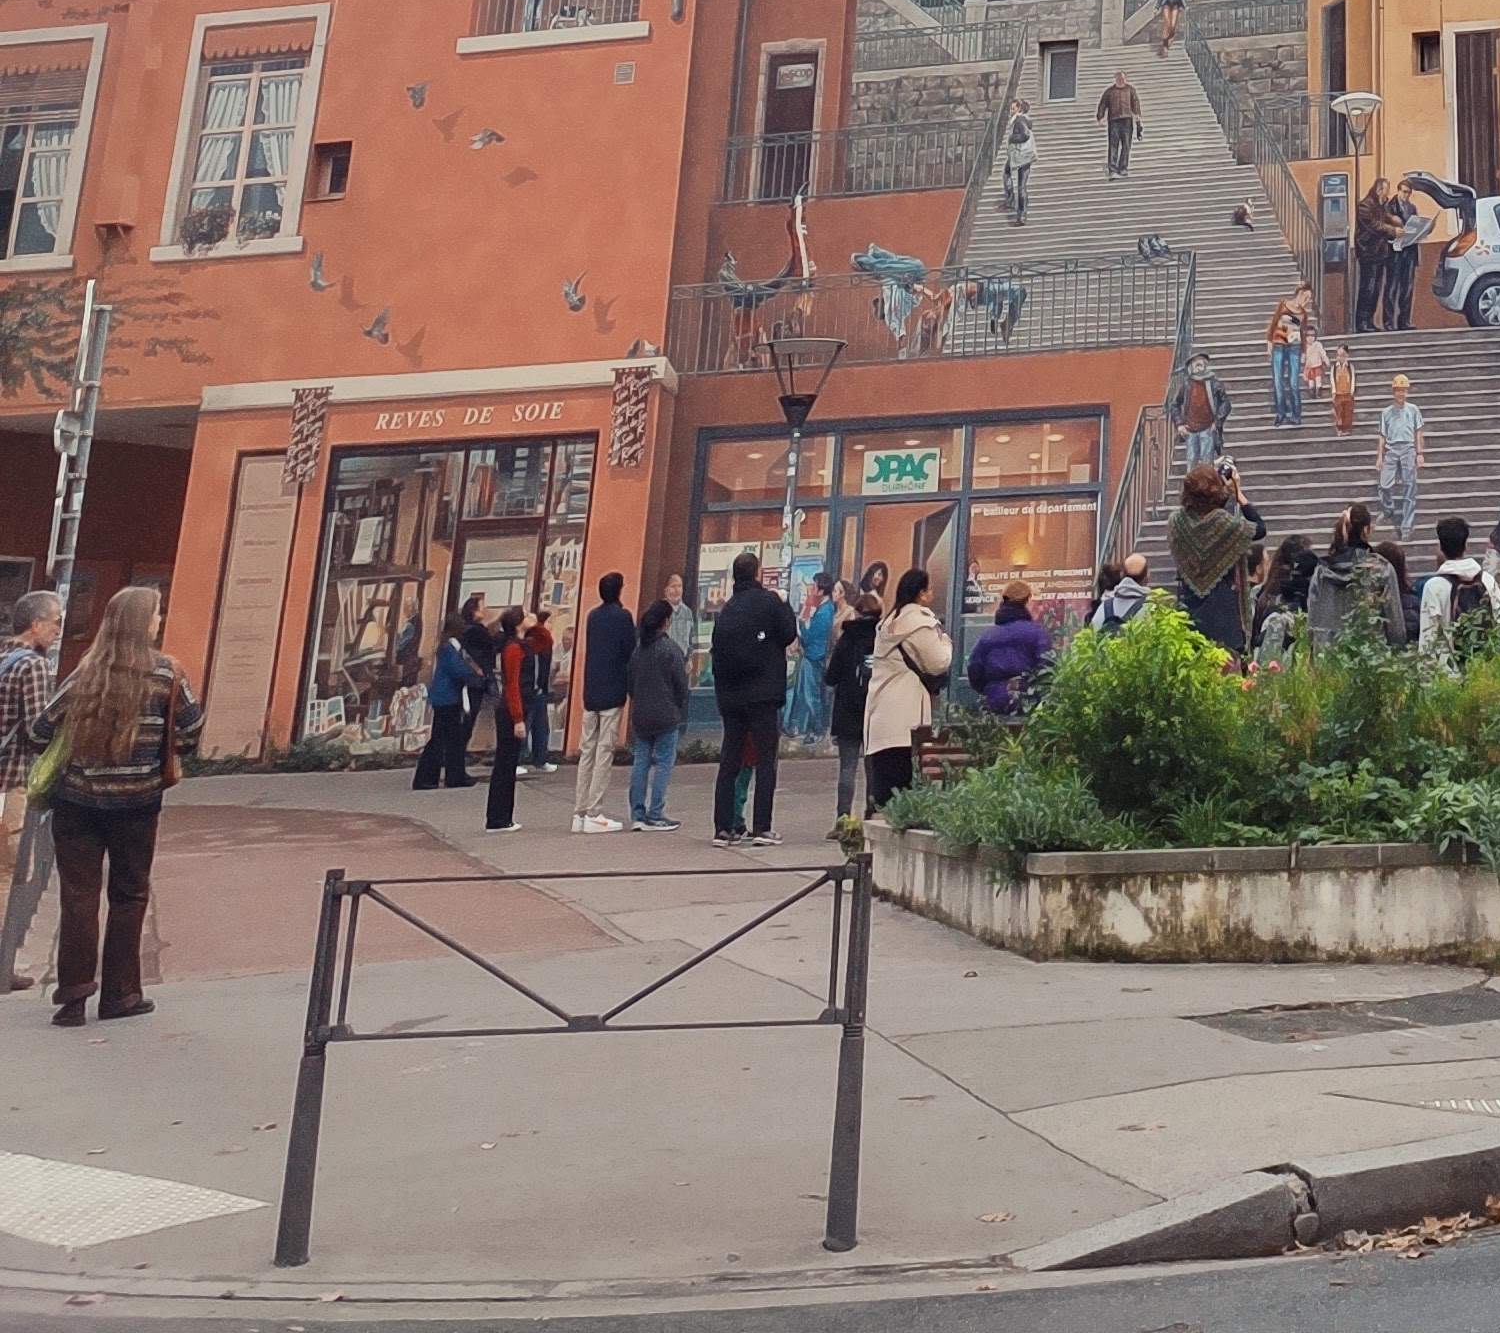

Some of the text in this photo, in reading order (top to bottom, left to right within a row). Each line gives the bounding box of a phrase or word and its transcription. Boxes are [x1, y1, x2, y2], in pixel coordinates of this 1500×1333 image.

[374, 401, 565, 430] REVES DE SOIE
